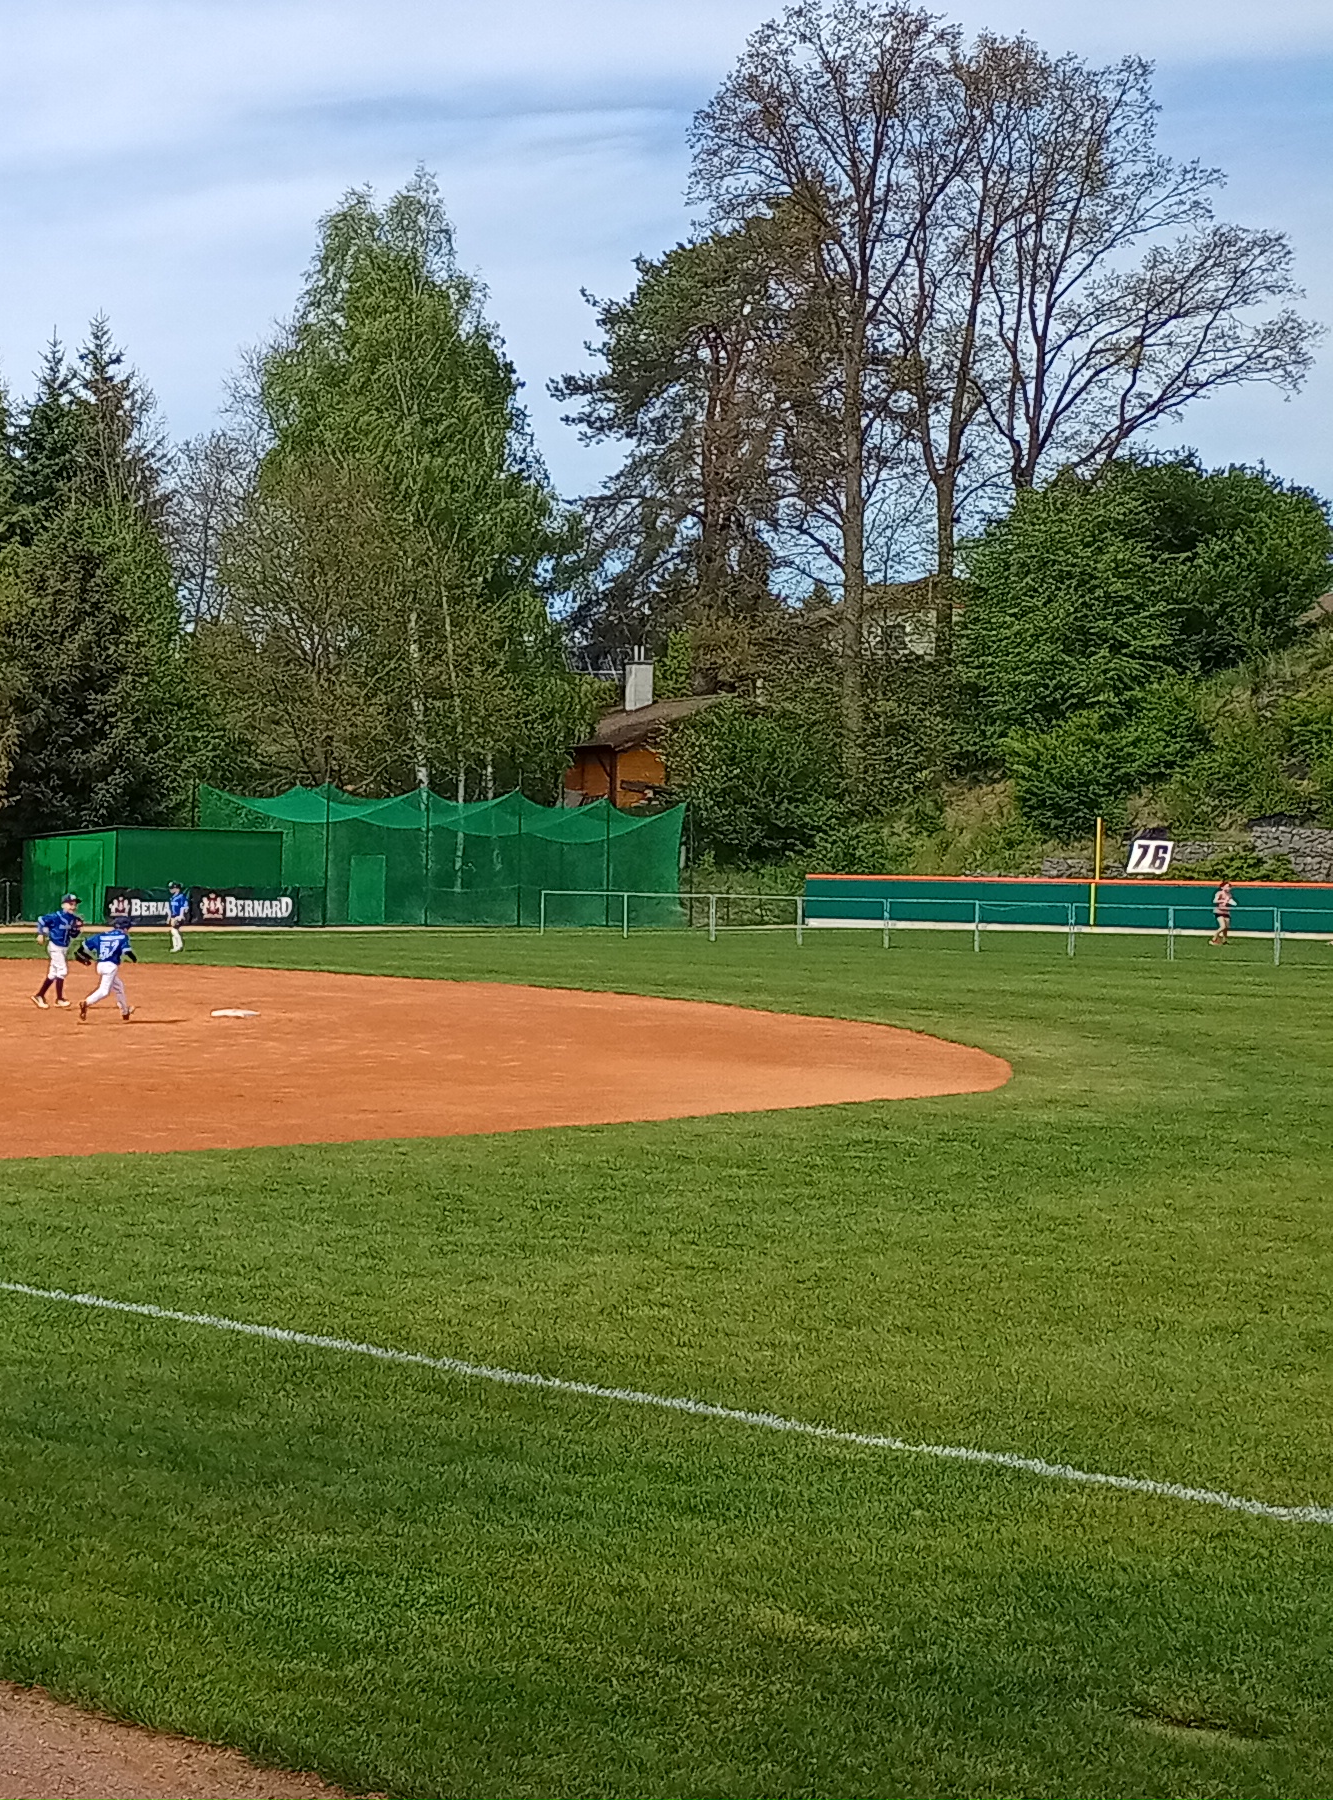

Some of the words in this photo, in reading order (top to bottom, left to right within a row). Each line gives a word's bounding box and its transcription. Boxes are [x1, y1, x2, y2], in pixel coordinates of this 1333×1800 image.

[1133, 844, 1169, 870] 76
[131, 898, 171, 916] BERNA
[225, 896, 293, 918] BERNARD
